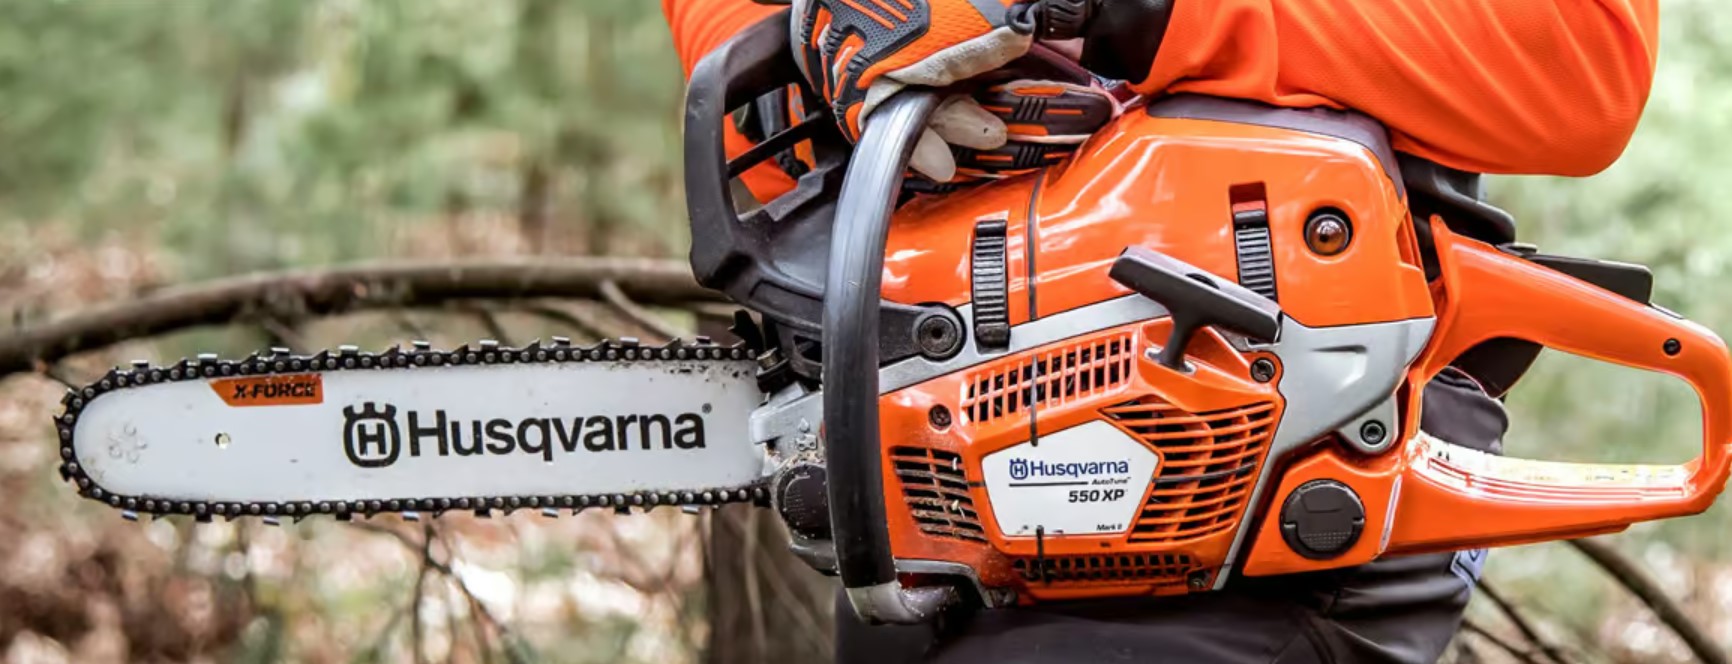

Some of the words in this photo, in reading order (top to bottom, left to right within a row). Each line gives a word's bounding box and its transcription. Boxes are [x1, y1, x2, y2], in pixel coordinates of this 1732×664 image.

[232, 382, 317, 399] X-FORCE
[407, 409, 706, 462] Husqvarna
[1030, 460, 1129, 478] Husqvarna
[1068, 490, 1100, 503] 550
[1101, 489, 1125, 501] XP
